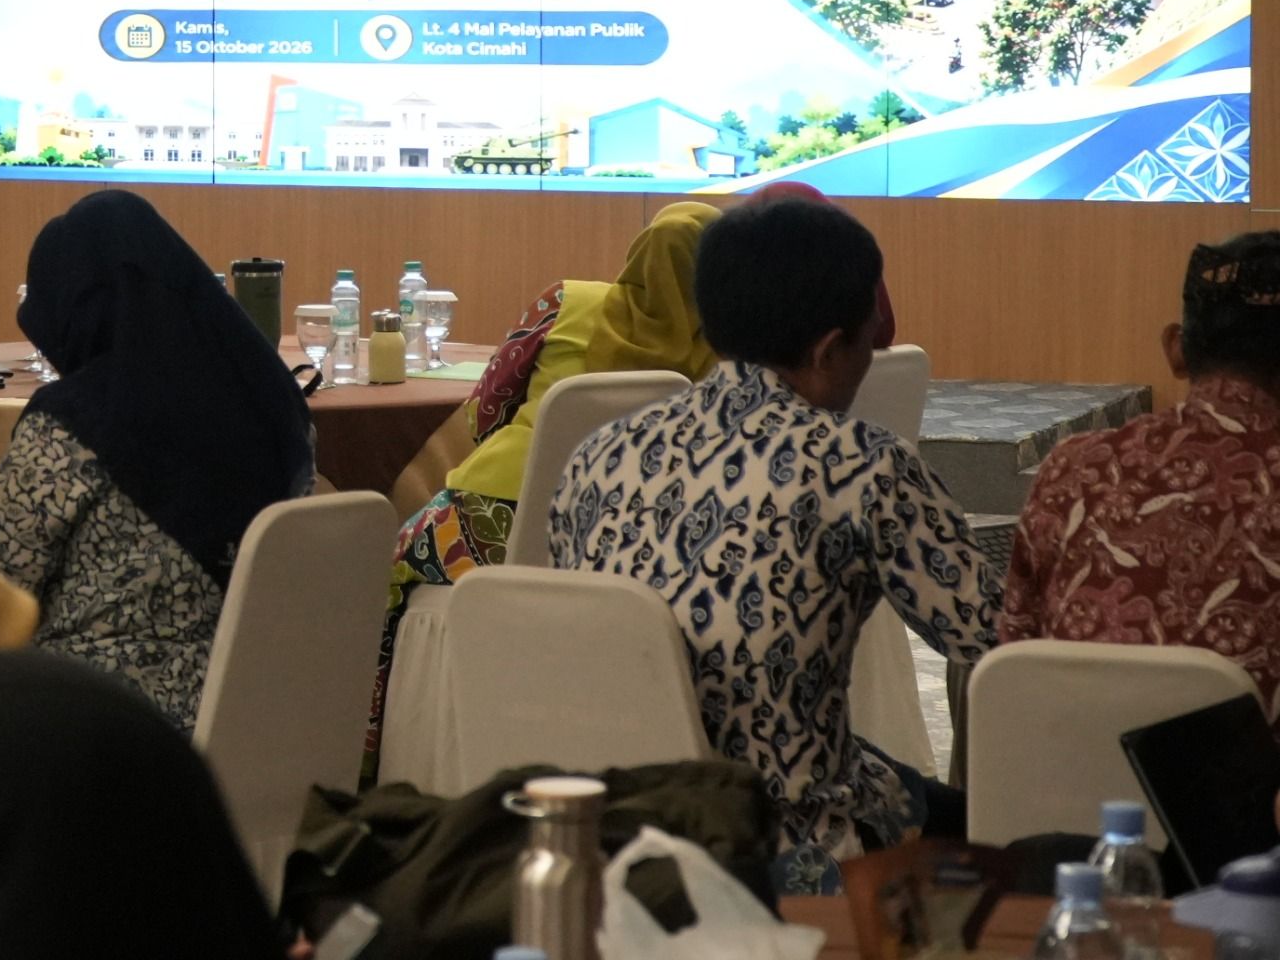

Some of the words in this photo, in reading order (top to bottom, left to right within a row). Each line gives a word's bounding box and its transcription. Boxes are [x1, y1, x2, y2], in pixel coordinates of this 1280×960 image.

[175, 21, 230, 36] Kamis,
[422, 22, 443, 36] Lt.
[448, 22, 460, 36] 4
[464, 22, 495, 36] Mal
[499, 22, 586, 39] Pelayanan
[590, 22, 645, 37] Publik
[175, 41, 192, 54] 15
[196, 40, 265, 54] Oktober
[268, 41, 313, 54] 2026
[422, 42, 463, 55] Kota
[467, 42, 527, 55] Cimahi
